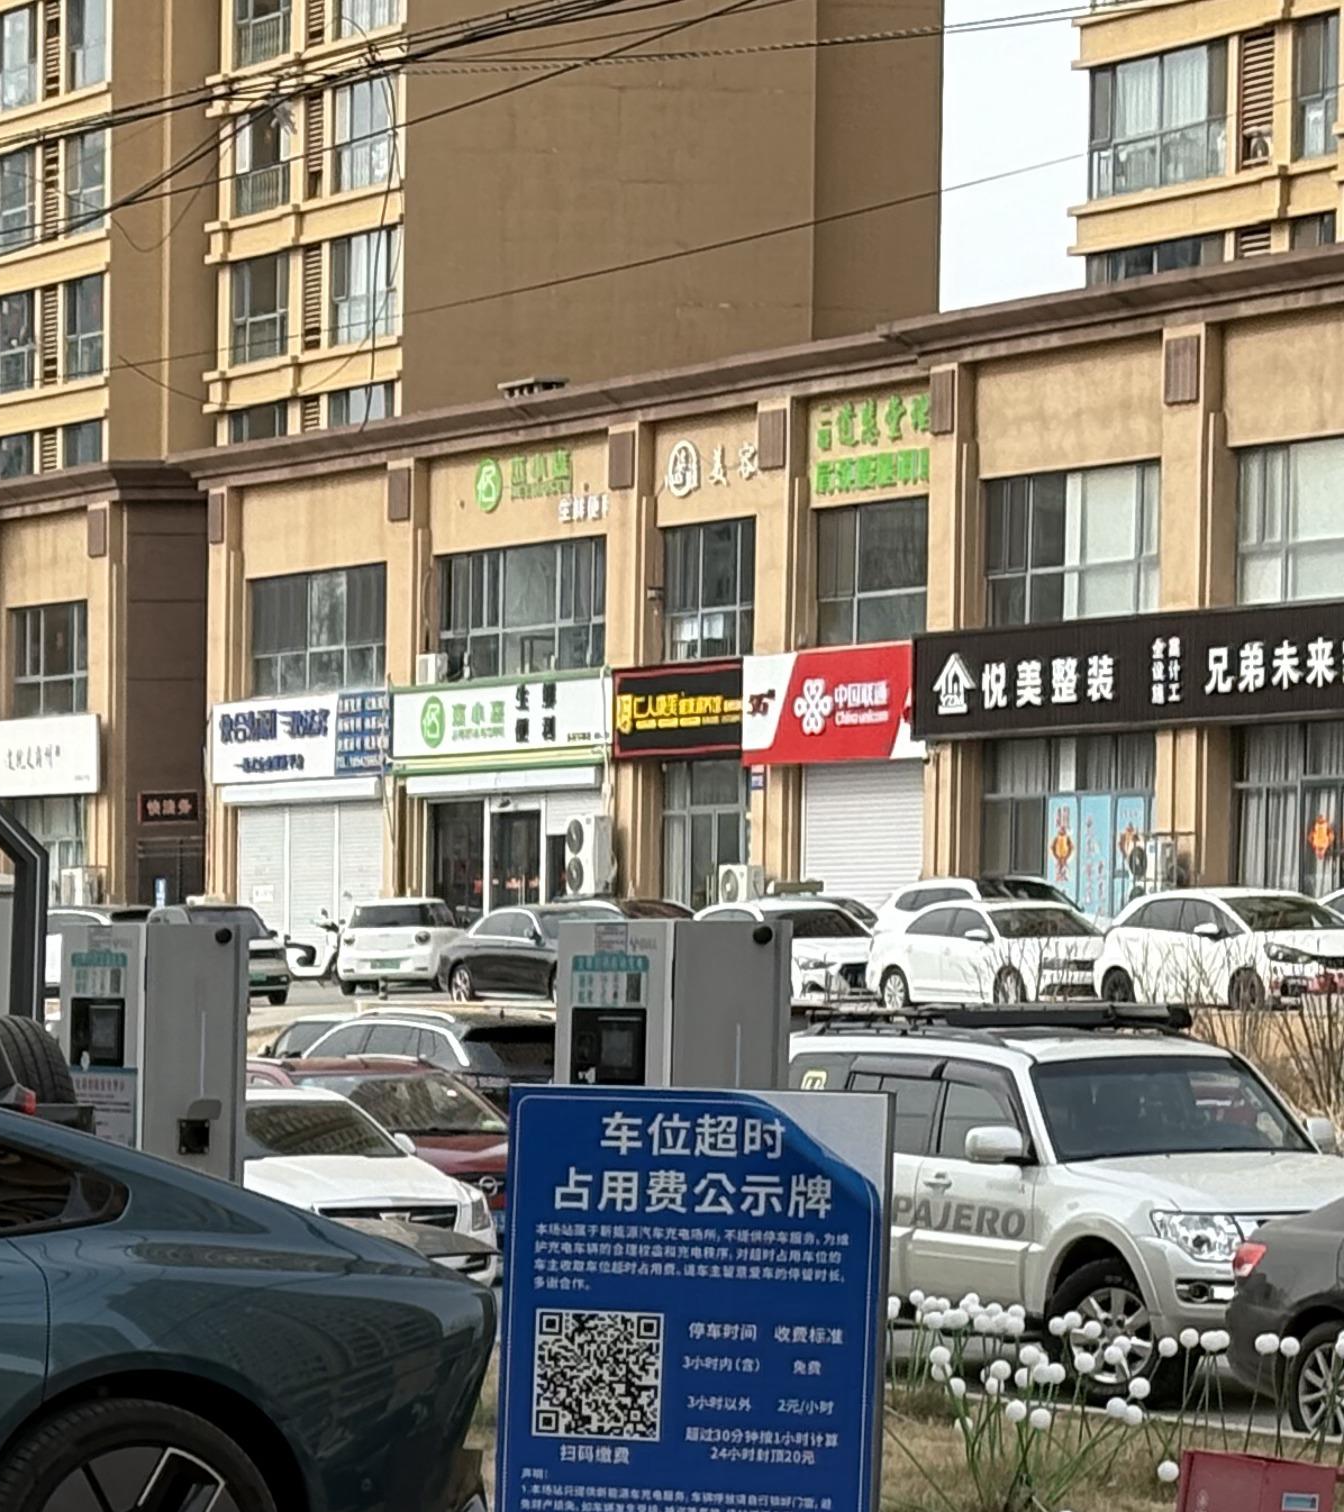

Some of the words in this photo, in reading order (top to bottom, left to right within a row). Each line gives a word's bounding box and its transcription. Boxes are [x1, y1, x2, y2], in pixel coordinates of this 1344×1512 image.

[1204, 637, 1344, 695] 兄弟未来
[982, 654, 1113, 709] 悦美整装
[835, 681, 888, 709] 中国联通
[600, 1112, 786, 1159] 车位超时
[554, 1166, 833, 1219] 占用费公示牌
[892, 1194, 1026, 1239] PAJERO
[689, 1322, 757, 1341] 停车时间
[774, 1325, 843, 1344] 收费标准
[793, 1360, 821, 1375] 免费
[687, 1395, 752, 1412] 3小时以外
[777, 1399, 834, 1415] 2元/小时
[685, 1427, 838, 1447] 超过30分钟按1小时计算
[560, 1445, 629, 1464] 扫码缴费
[710, 1447, 815, 1465] 24小时封顶20元
